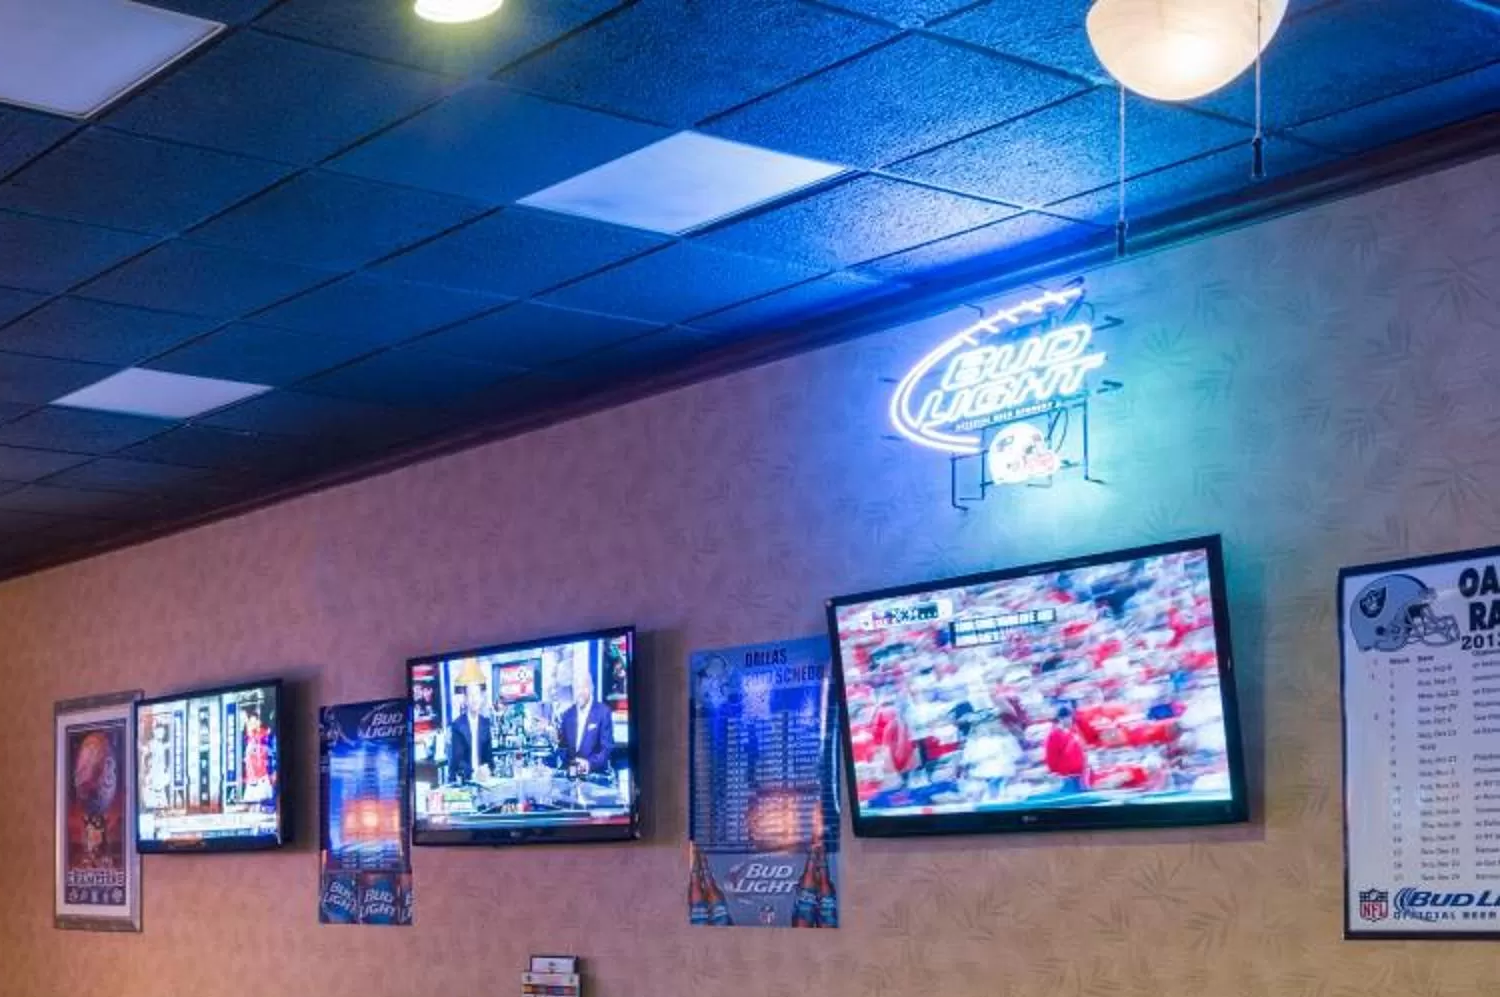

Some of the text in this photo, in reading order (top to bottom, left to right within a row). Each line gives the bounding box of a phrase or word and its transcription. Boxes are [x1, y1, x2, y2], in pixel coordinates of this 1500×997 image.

[942, 323, 1092, 391] BUD
[916, 352, 1107, 429] LIGHT
[1458, 564, 1500, 598] OA
[1461, 632, 1500, 651] 201
[745, 647, 787, 668] DALLAS
[371, 712, 404, 726] BUD
[365, 724, 406, 739] LIGHT
[746, 862, 794, 879] BUD
[734, 878, 800, 894] LIGHT
[363, 887, 395, 903] BUD
[1409, 890, 1475, 907] BUD
[1363, 902, 1384, 919] NFL
